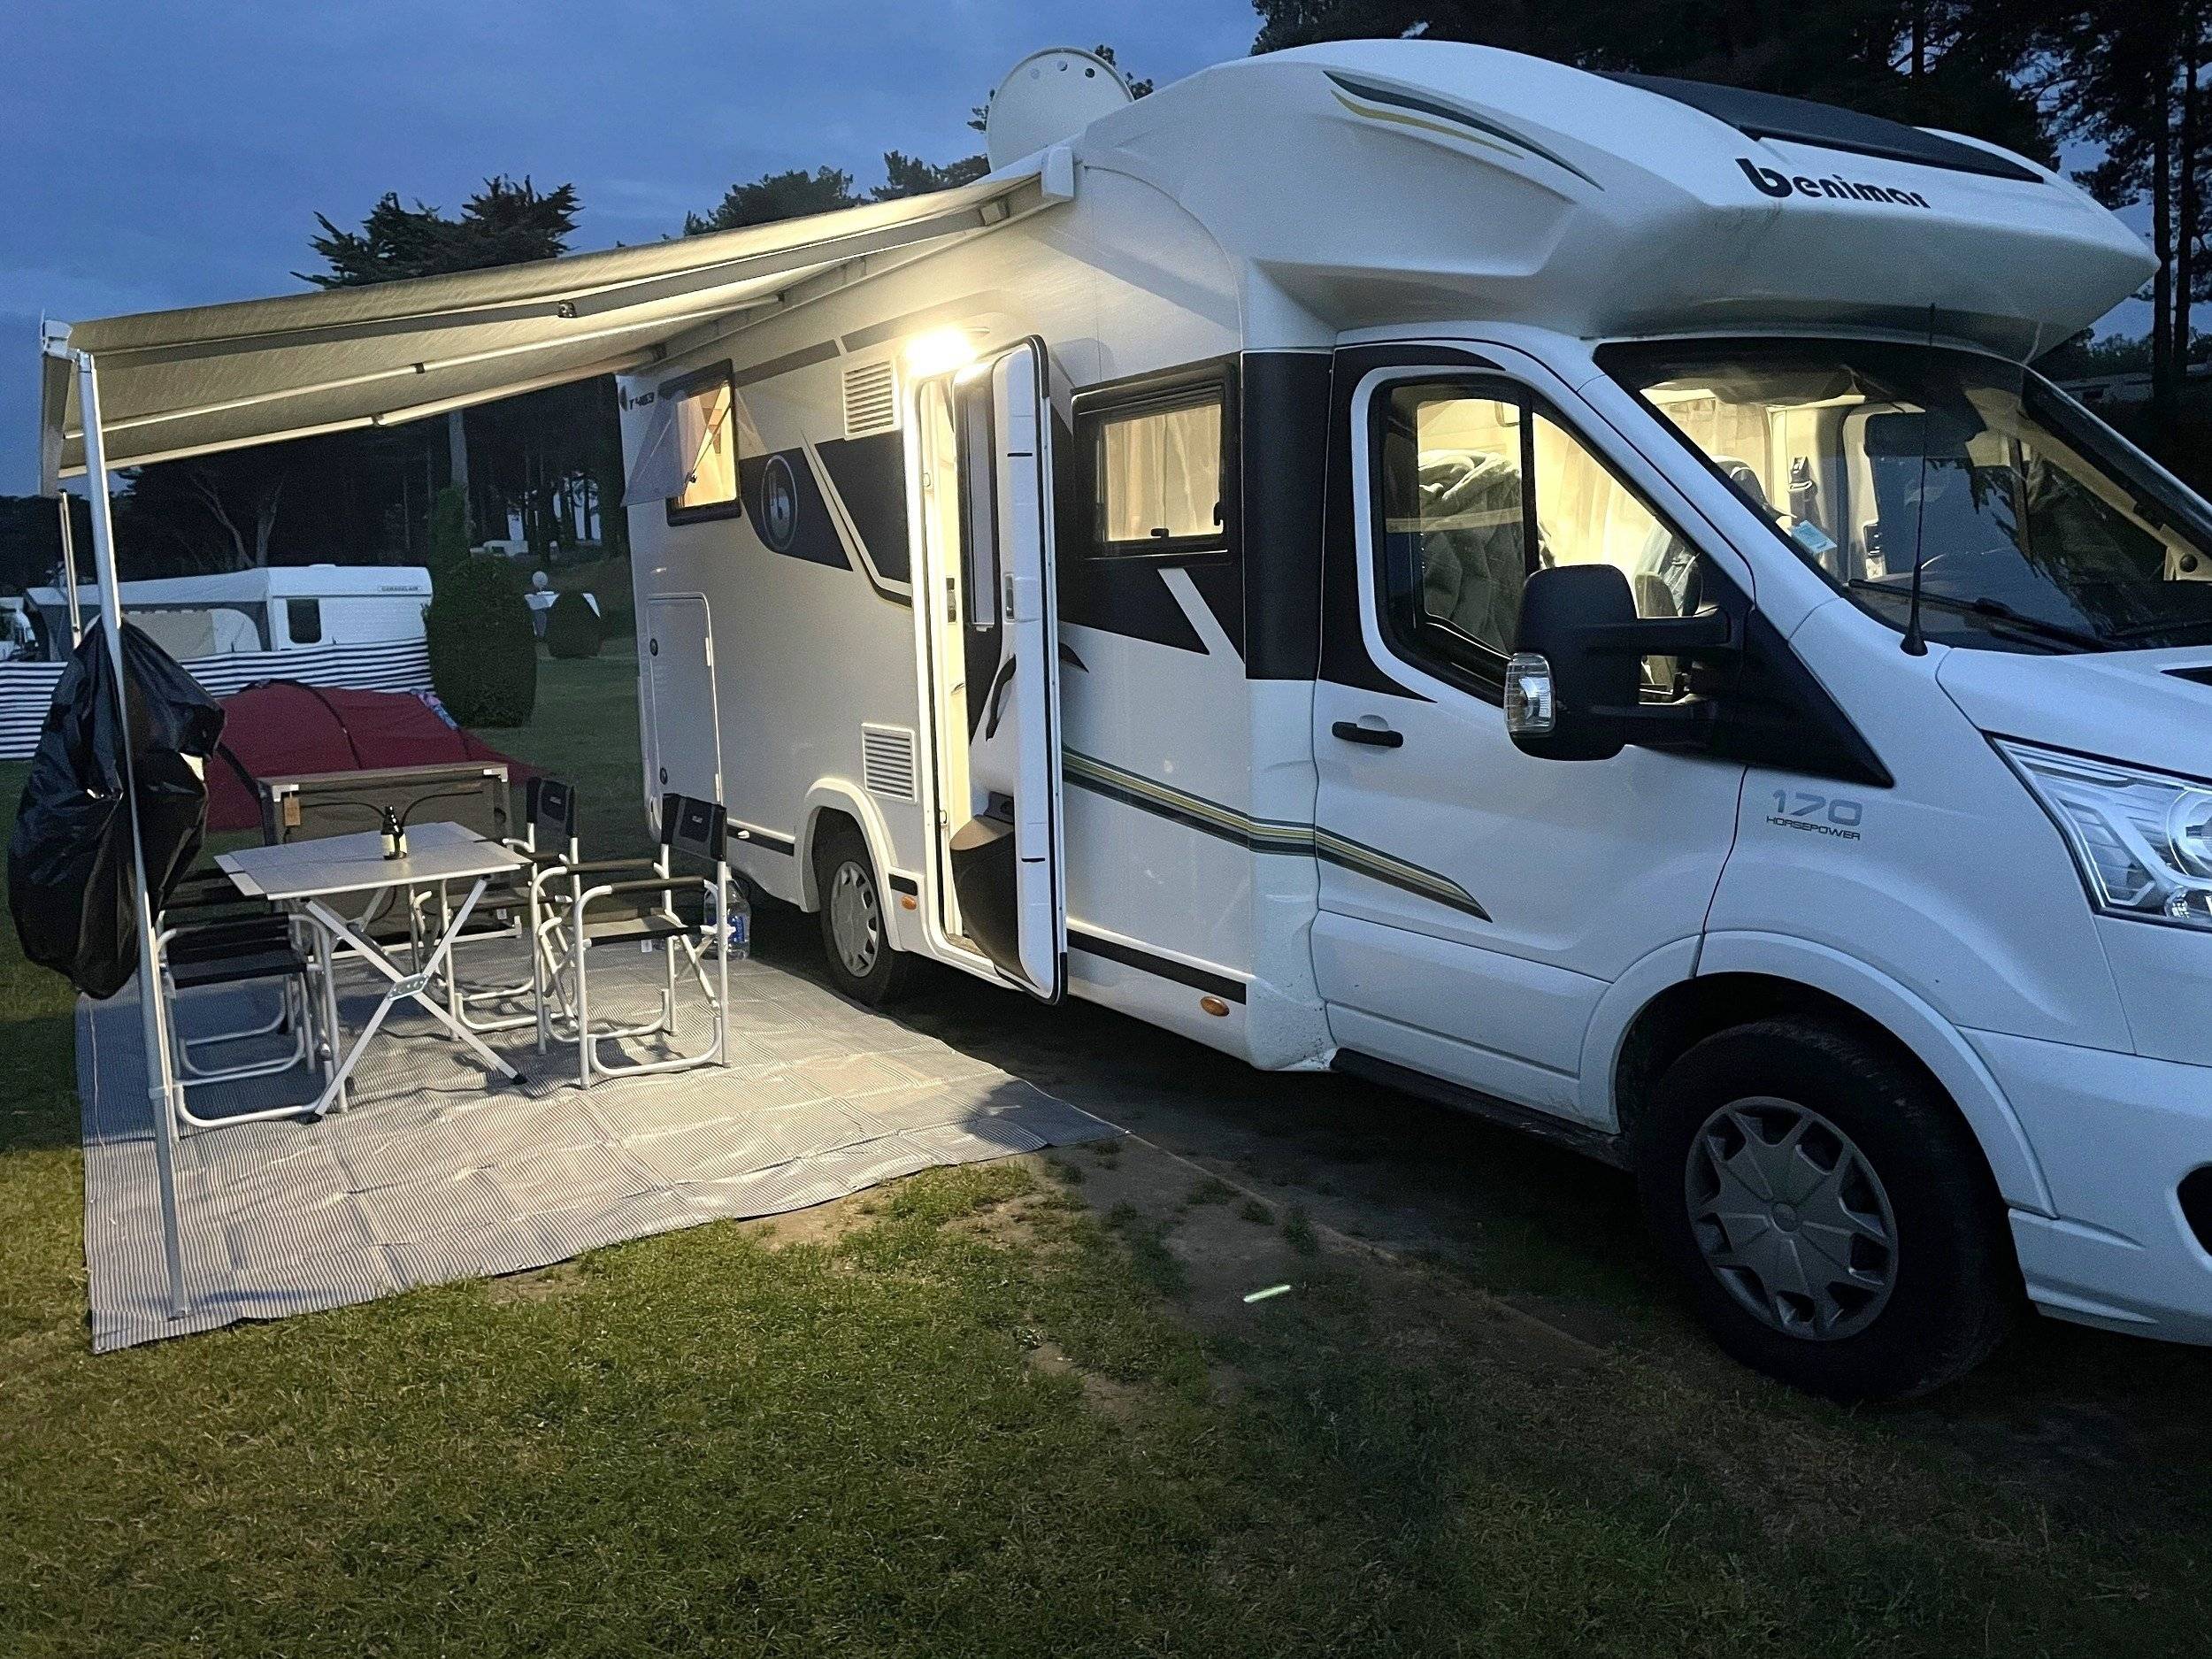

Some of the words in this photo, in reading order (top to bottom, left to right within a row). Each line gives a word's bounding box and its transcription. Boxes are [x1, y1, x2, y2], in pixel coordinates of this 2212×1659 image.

[1734, 157, 1932, 209] benimar
[1772, 789, 1863, 826] 170
[1766, 816, 1861, 841] HORSEPOWER
